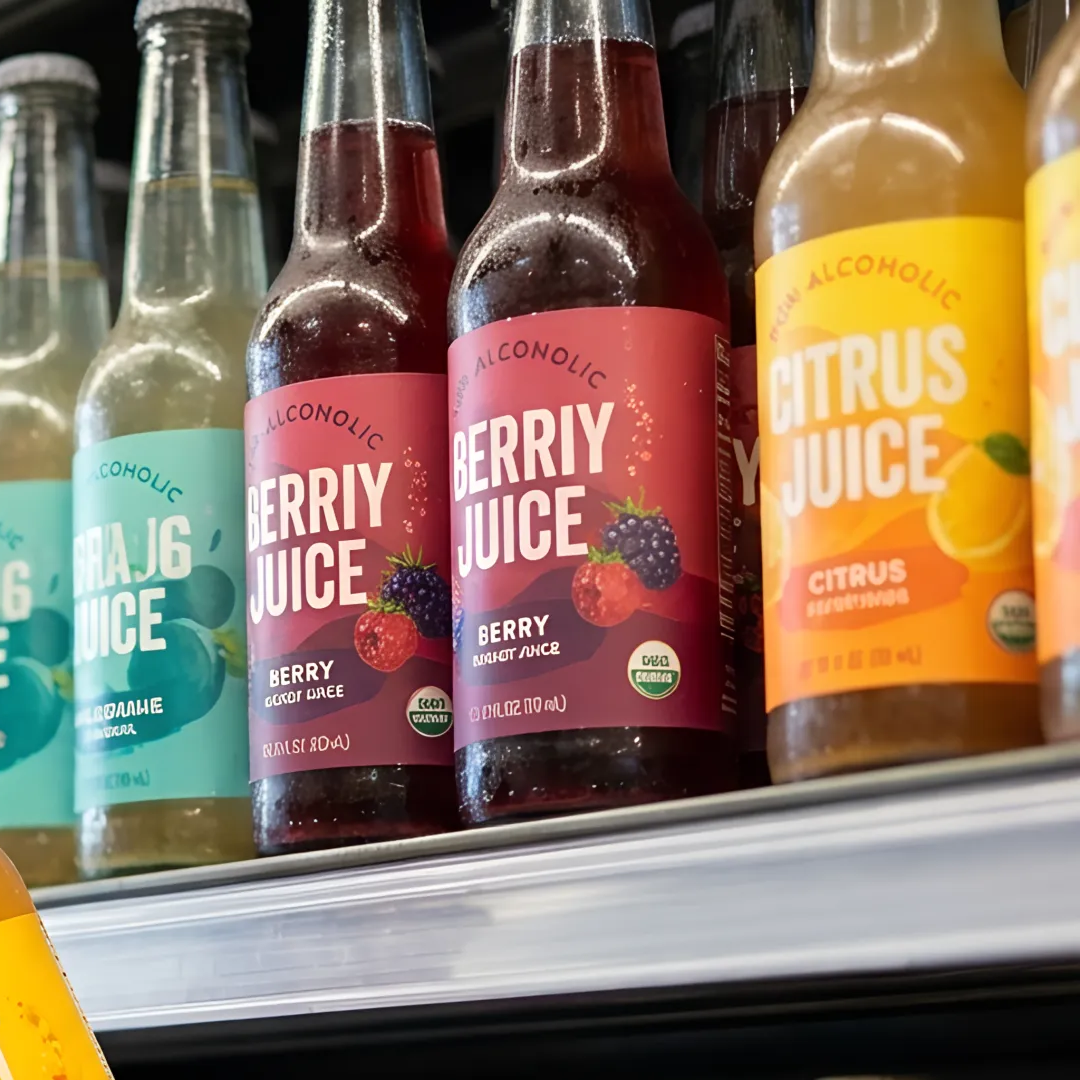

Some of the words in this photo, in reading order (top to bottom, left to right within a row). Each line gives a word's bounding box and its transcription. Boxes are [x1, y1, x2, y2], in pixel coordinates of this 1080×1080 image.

[769, 322, 968, 436] CITRUS
[454, 401, 615, 503] BERRIY
[781, 413, 948, 519] JUICE
[247, 461, 394, 552] BERRIY
[457, 485, 589, 578] JUICE
[250, 538, 368, 625] JUICE
[808, 557, 907, 596] CITRUS
[270, 660, 334, 687] BERRY
[478, 614, 550, 647] BERRY
